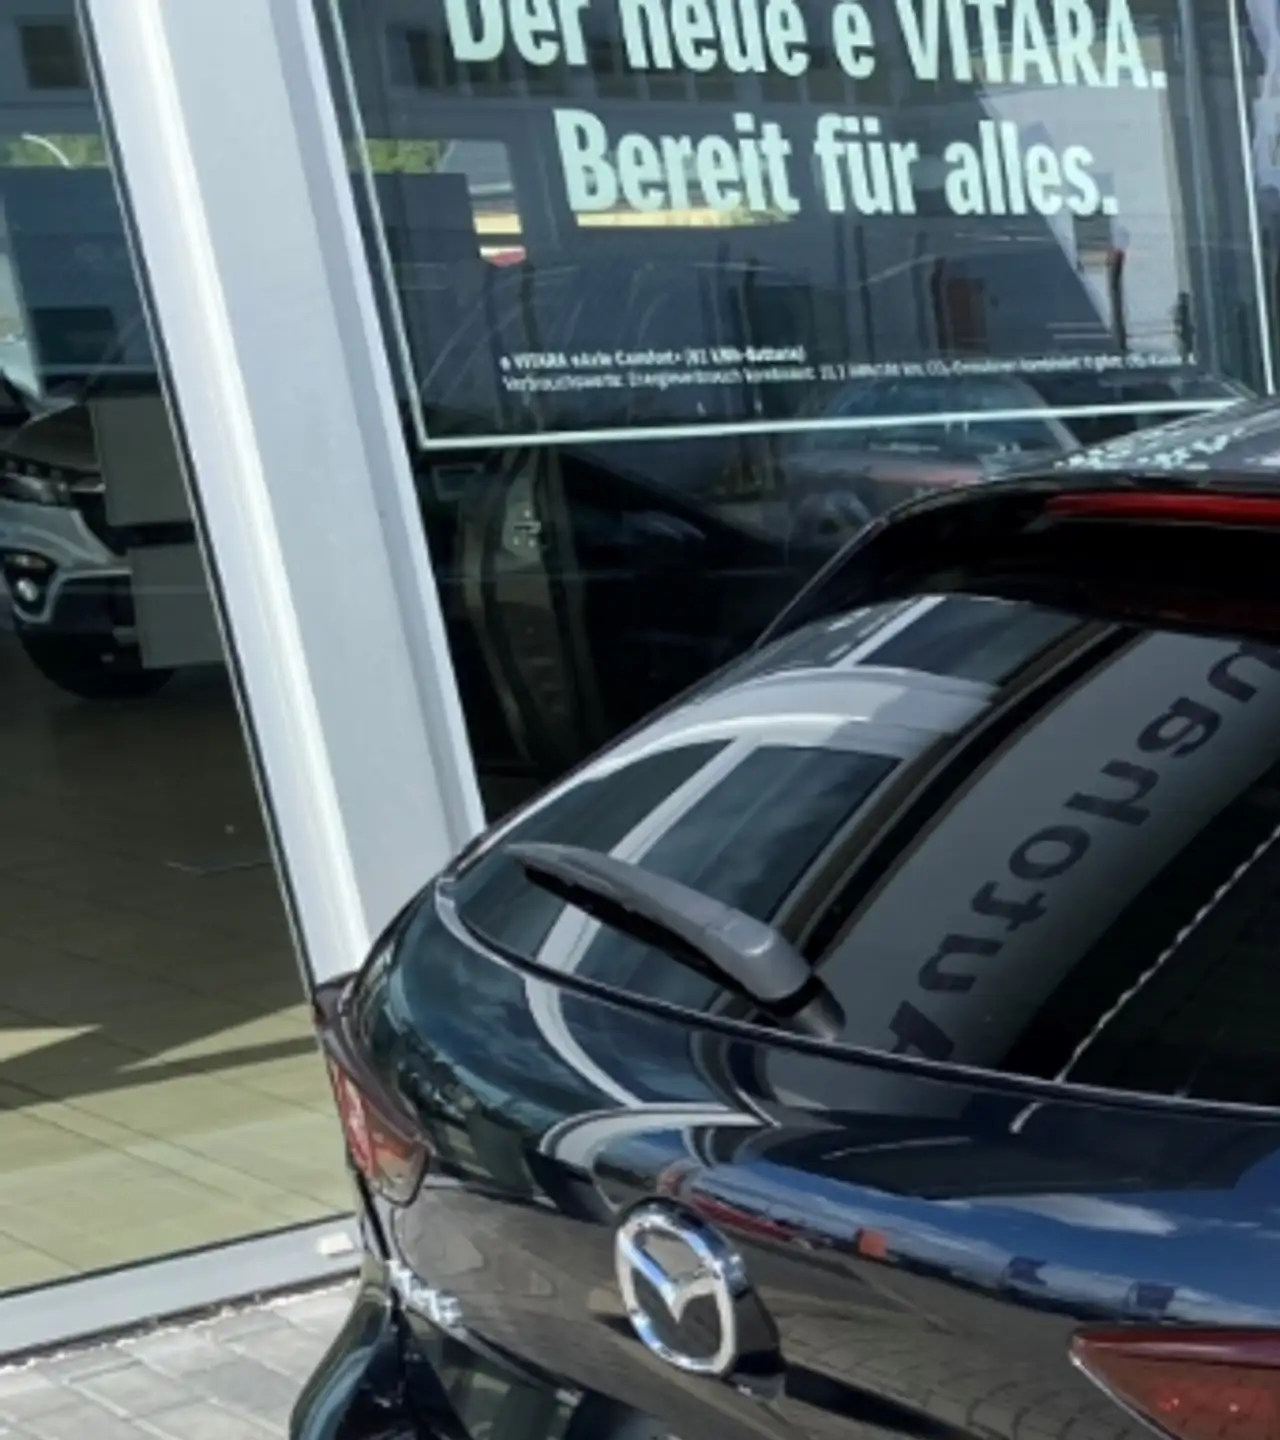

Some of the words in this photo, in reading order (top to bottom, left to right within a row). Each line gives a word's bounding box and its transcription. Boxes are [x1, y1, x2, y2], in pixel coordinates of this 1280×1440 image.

[444, 0, 592, 66] Der
[617, 0, 810, 76] neue
[832, 1, 875, 78] e
[895, 0, 1167, 88] VITARA.
[553, 109, 800, 212] Bereit
[814, 112, 919, 214] für
[944, 120, 1119, 216] alles.
